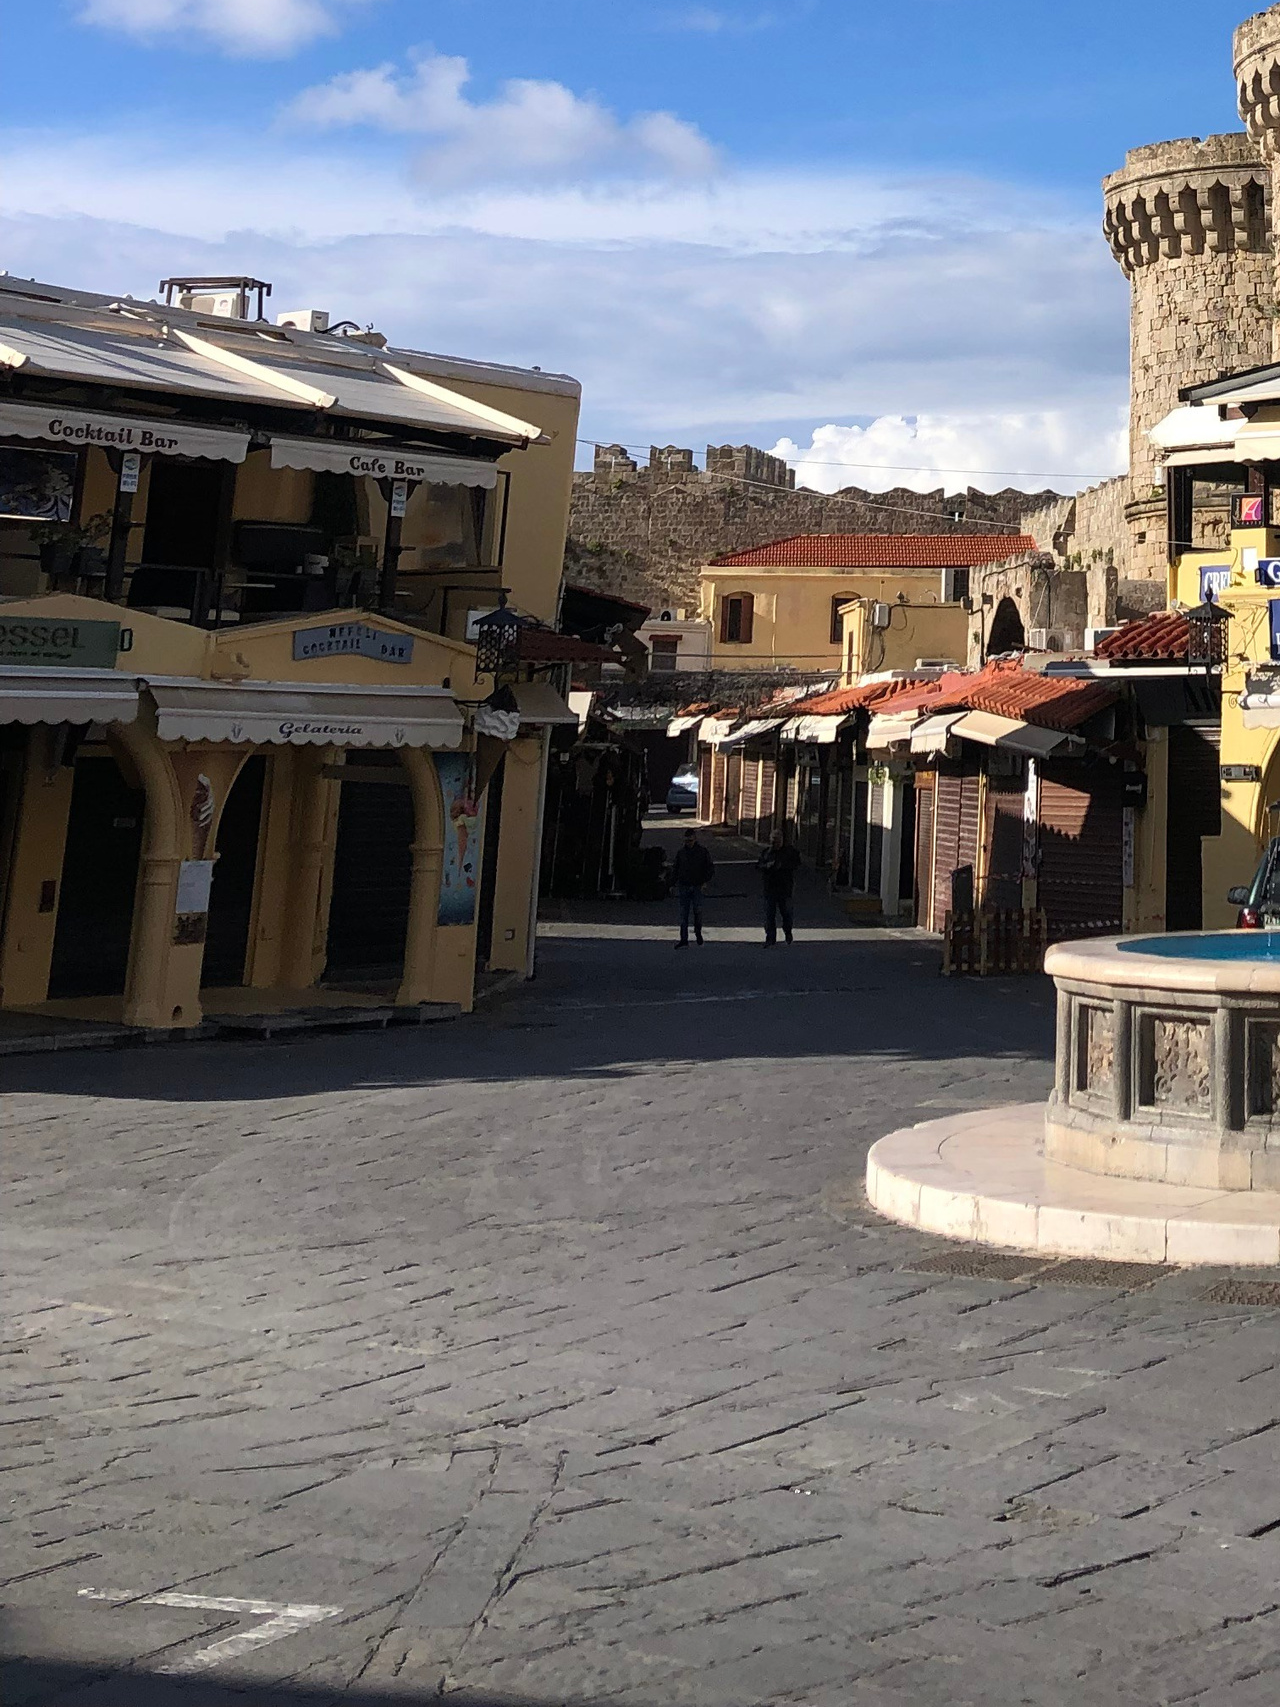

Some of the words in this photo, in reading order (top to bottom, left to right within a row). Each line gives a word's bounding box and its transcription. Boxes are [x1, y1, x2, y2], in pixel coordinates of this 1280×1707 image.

[48, 419, 134, 445] Cocktail
[139, 430, 179, 449] Bar
[349, 456, 386, 474] Cafe
[393, 461, 425, 477] Bar
[380, 644, 407, 658] BAR
[278, 721, 363, 738] Gelateria
